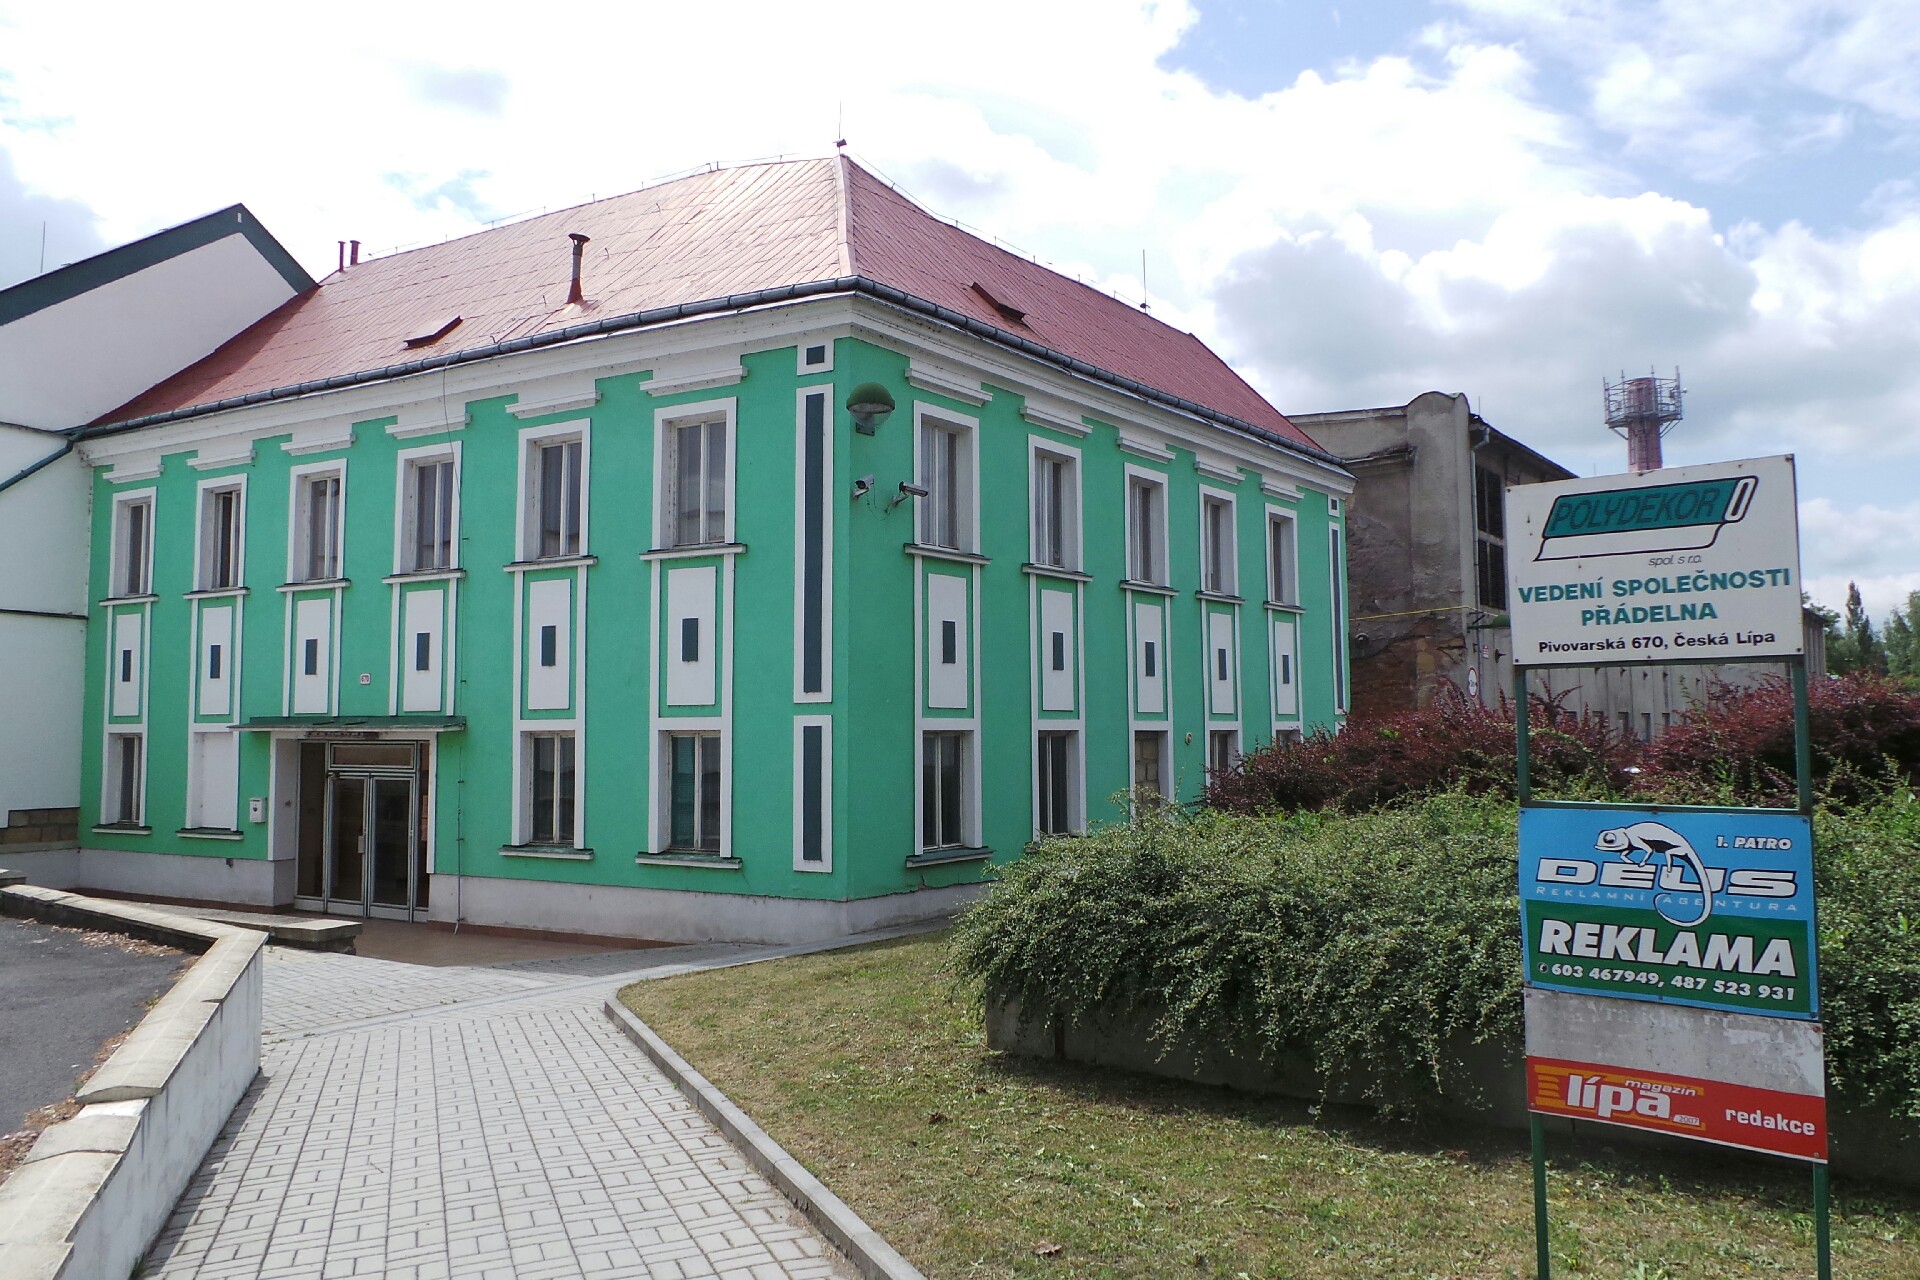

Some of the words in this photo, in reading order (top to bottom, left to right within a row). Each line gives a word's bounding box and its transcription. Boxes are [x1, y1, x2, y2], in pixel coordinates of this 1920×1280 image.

[1551, 488, 1721, 532] POLYDEKOR
[1678, 556, 1685, 564] s
[1518, 577, 1603, 603] VEDENÍ
[1612, 568, 1791, 598] SPOLEČNOSTI
[1581, 602, 1718, 627] PŘÁDELNA
[1539, 637, 1626, 653] Pivovarská
[1631, 635, 1669, 650] 670,
[1674, 632, 1729, 648] Česká
[1736, 631, 1776, 646] Lípa
[1733, 836, 1792, 850] PATRO
[1535, 886, 1645, 902] REKLAMNÍ
[1662, 896, 1797, 912] AGENTURA
[1538, 919, 1797, 979] REKLAMA
[1551, 963, 1584, 978] 603
[1588, 967, 1664, 988] 467949,
[1670, 975, 1707, 990] 487
[1712, 980, 1751, 997] 523
[1757, 985, 1795, 1001] 931
[1566, 1074, 1671, 1119] lípa
[1624, 1079, 1697, 1097] magazin
[1724, 1107, 1816, 1136] redakce
